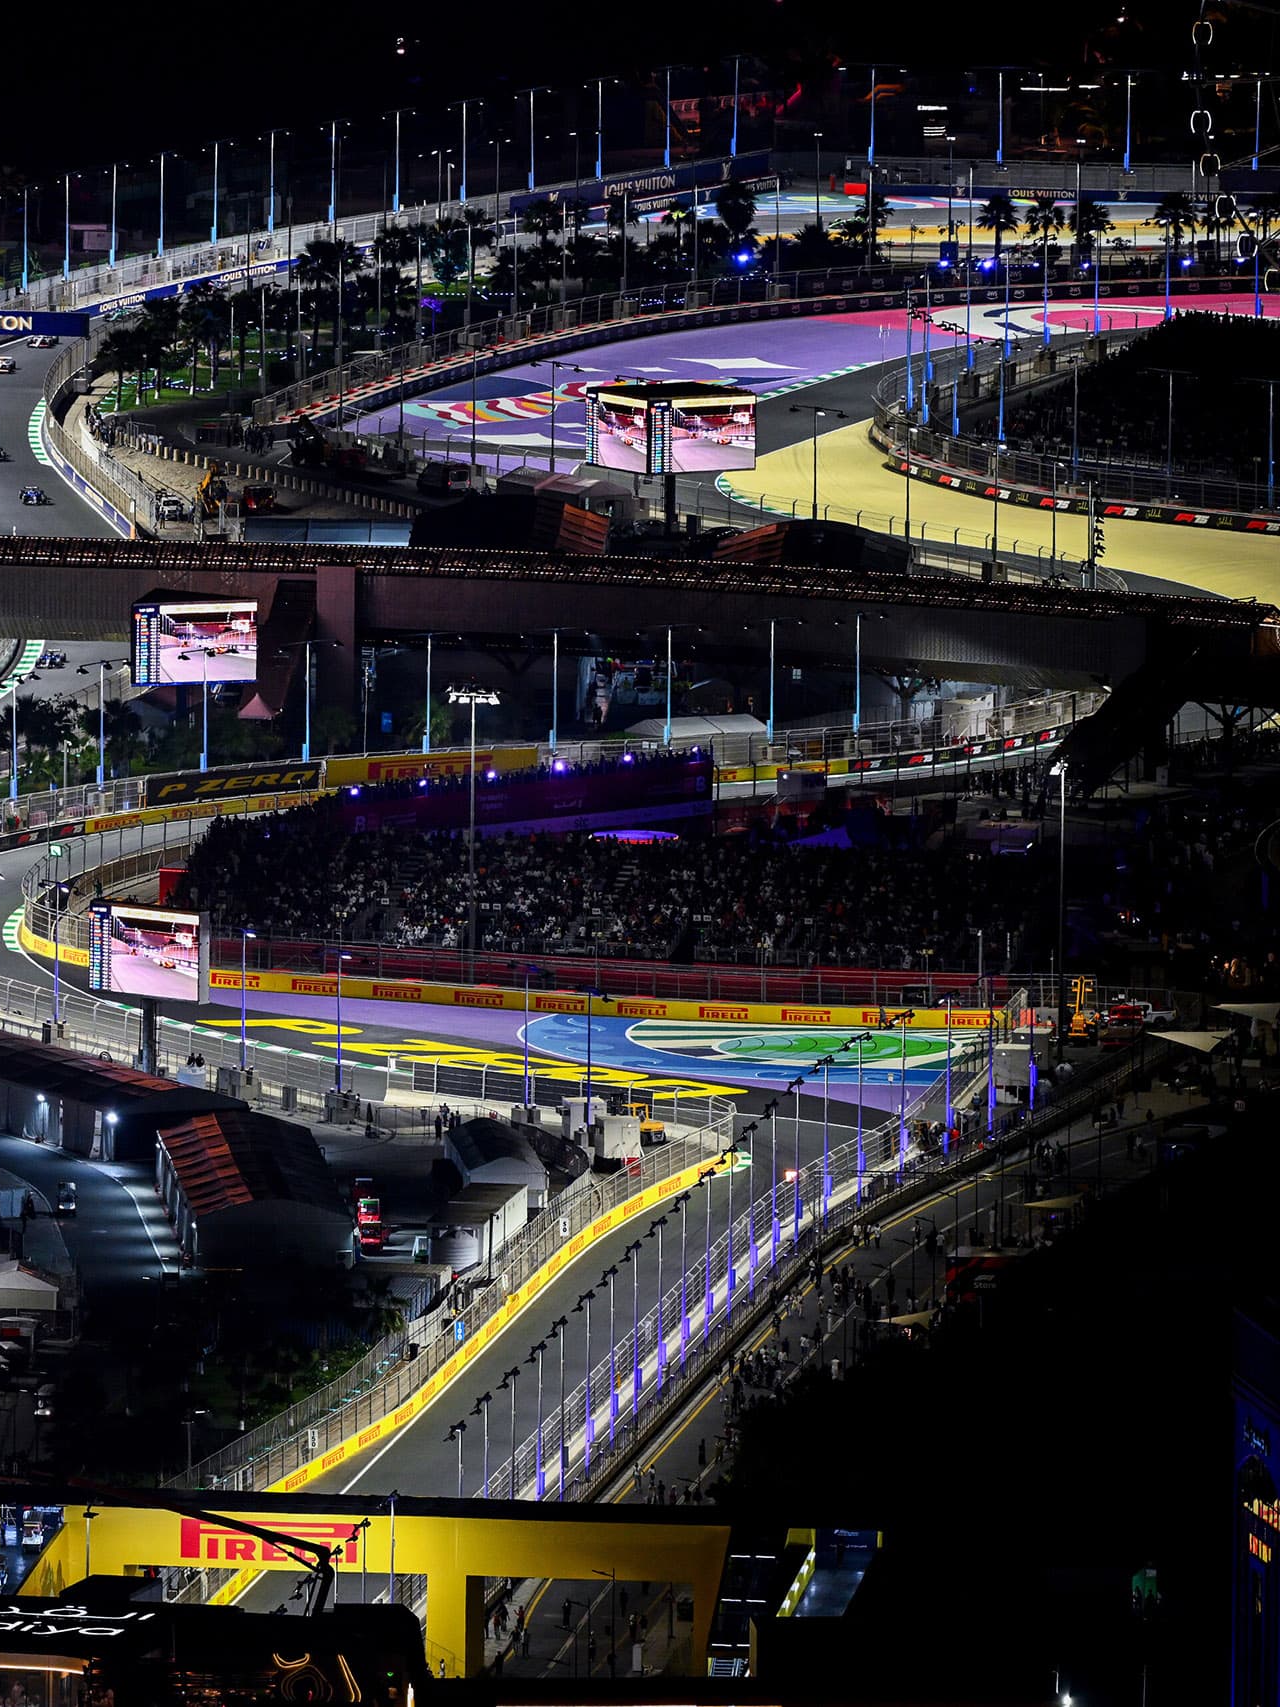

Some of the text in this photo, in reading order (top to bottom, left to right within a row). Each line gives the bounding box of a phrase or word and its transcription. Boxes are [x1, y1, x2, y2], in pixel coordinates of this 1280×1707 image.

[1008, 190, 1076, 200] LOUIS VUITTON
[220, 264, 277, 282] LOUIS VUITTON
[99, 294, 146, 312] LOUIS VUITTON
[158, 770, 316, 798] P ZERO
[210, 972, 261, 988] PIRELLI
[291, 979, 340, 994] PIRELL
[372, 985, 422, 1000] PIRELLI
[454, 991, 504, 1006] PIRELLI
[536, 996, 585, 1012] PIRELLI
[617, 1002, 667, 1016] PIRELLI
[699, 1006, 749, 1020] PIRELLI
[781, 1009, 831, 1023] PIRELLI
[659, 1176, 682, 1197] PIRELLI
[624, 1196, 643, 1216] PIRELLI
[594, 1216, 611, 1236] PIRELLI
[395, 1403, 413, 1425] PIRELLI
[359, 1425, 380, 1448] PIRELLI
[322, 1447, 344, 1470] PIRELLI
[285, 1469, 308, 1491] PIRELLI
